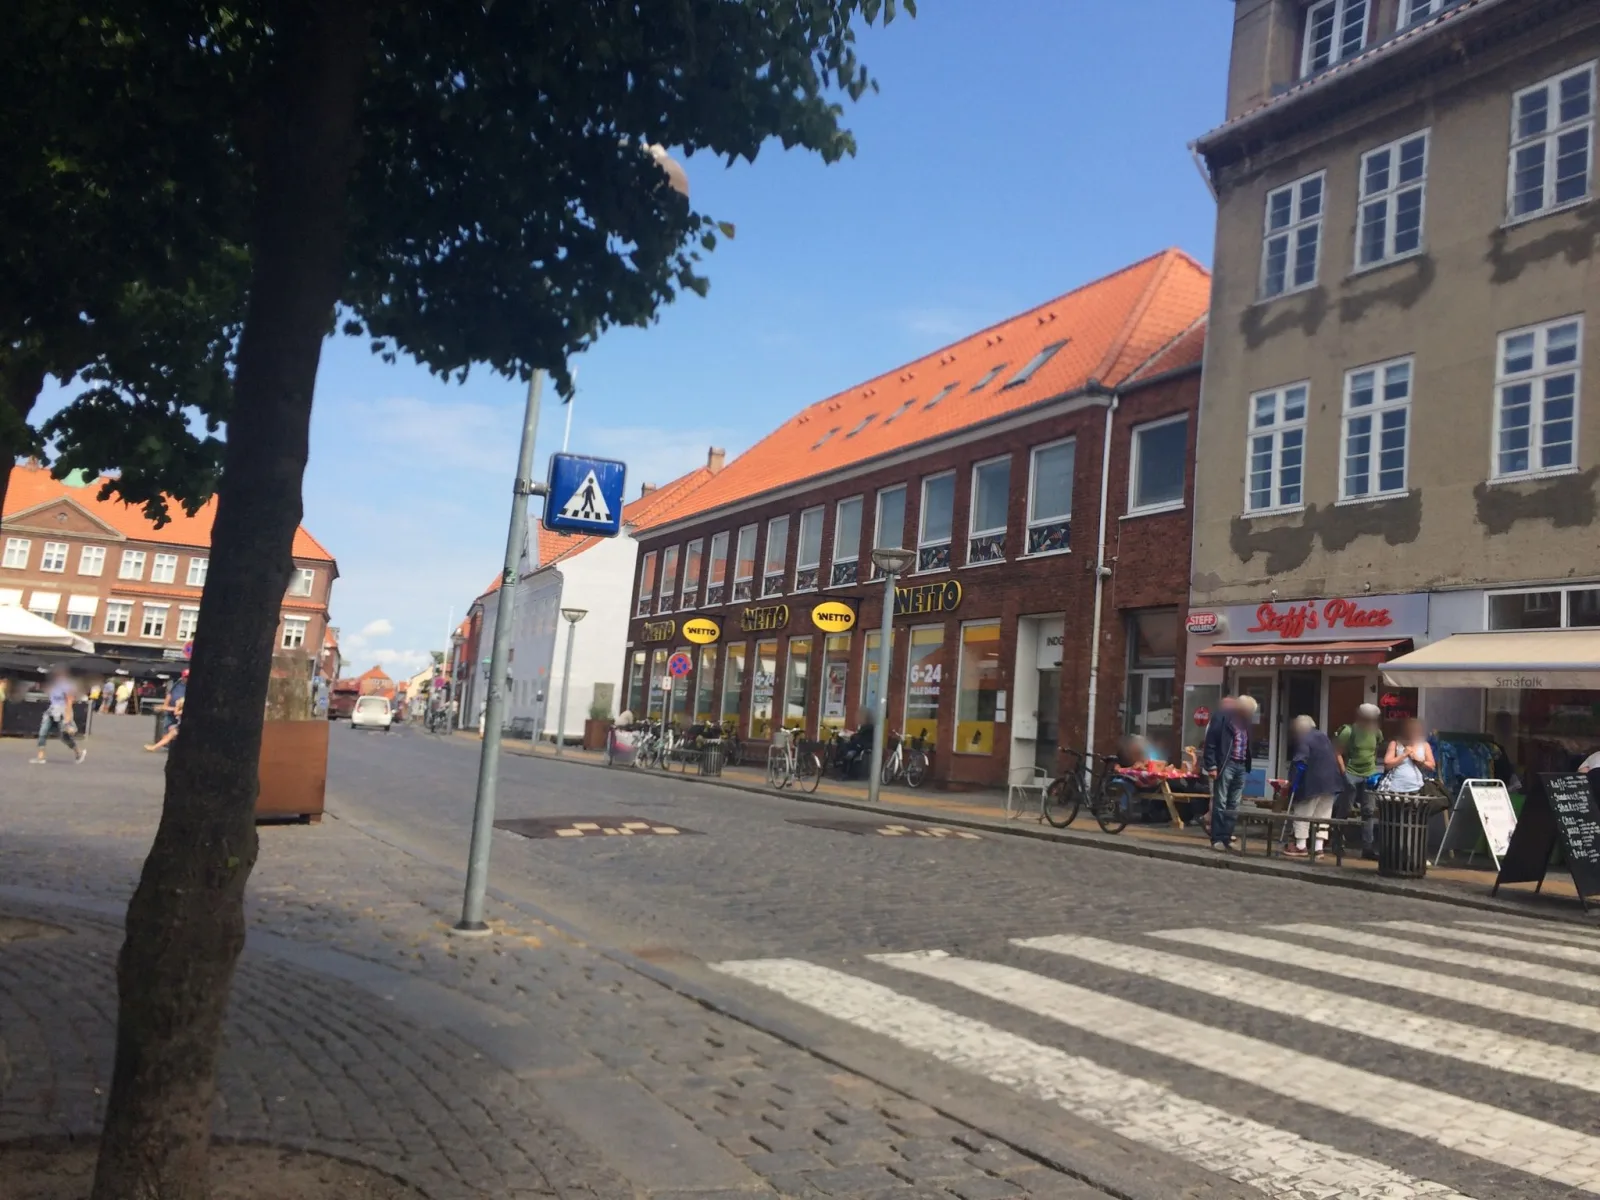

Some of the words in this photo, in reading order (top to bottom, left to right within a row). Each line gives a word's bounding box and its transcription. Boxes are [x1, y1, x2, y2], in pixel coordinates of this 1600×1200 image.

[894, 580, 961, 615] NETTO
[742, 604, 789, 631] NETTO
[817, 610, 852, 623] NETTO
[1190, 614, 1214, 625] STEFF
[1248, 600, 1319, 638] Steff's
[1323, 598, 1392, 627] Place
[688, 627, 717, 637] NETTO
[1225, 655, 1277, 667] Torvets
[911, 663, 942, 684] 6-24
[1495, 676, 1543, 689] Småfolk
